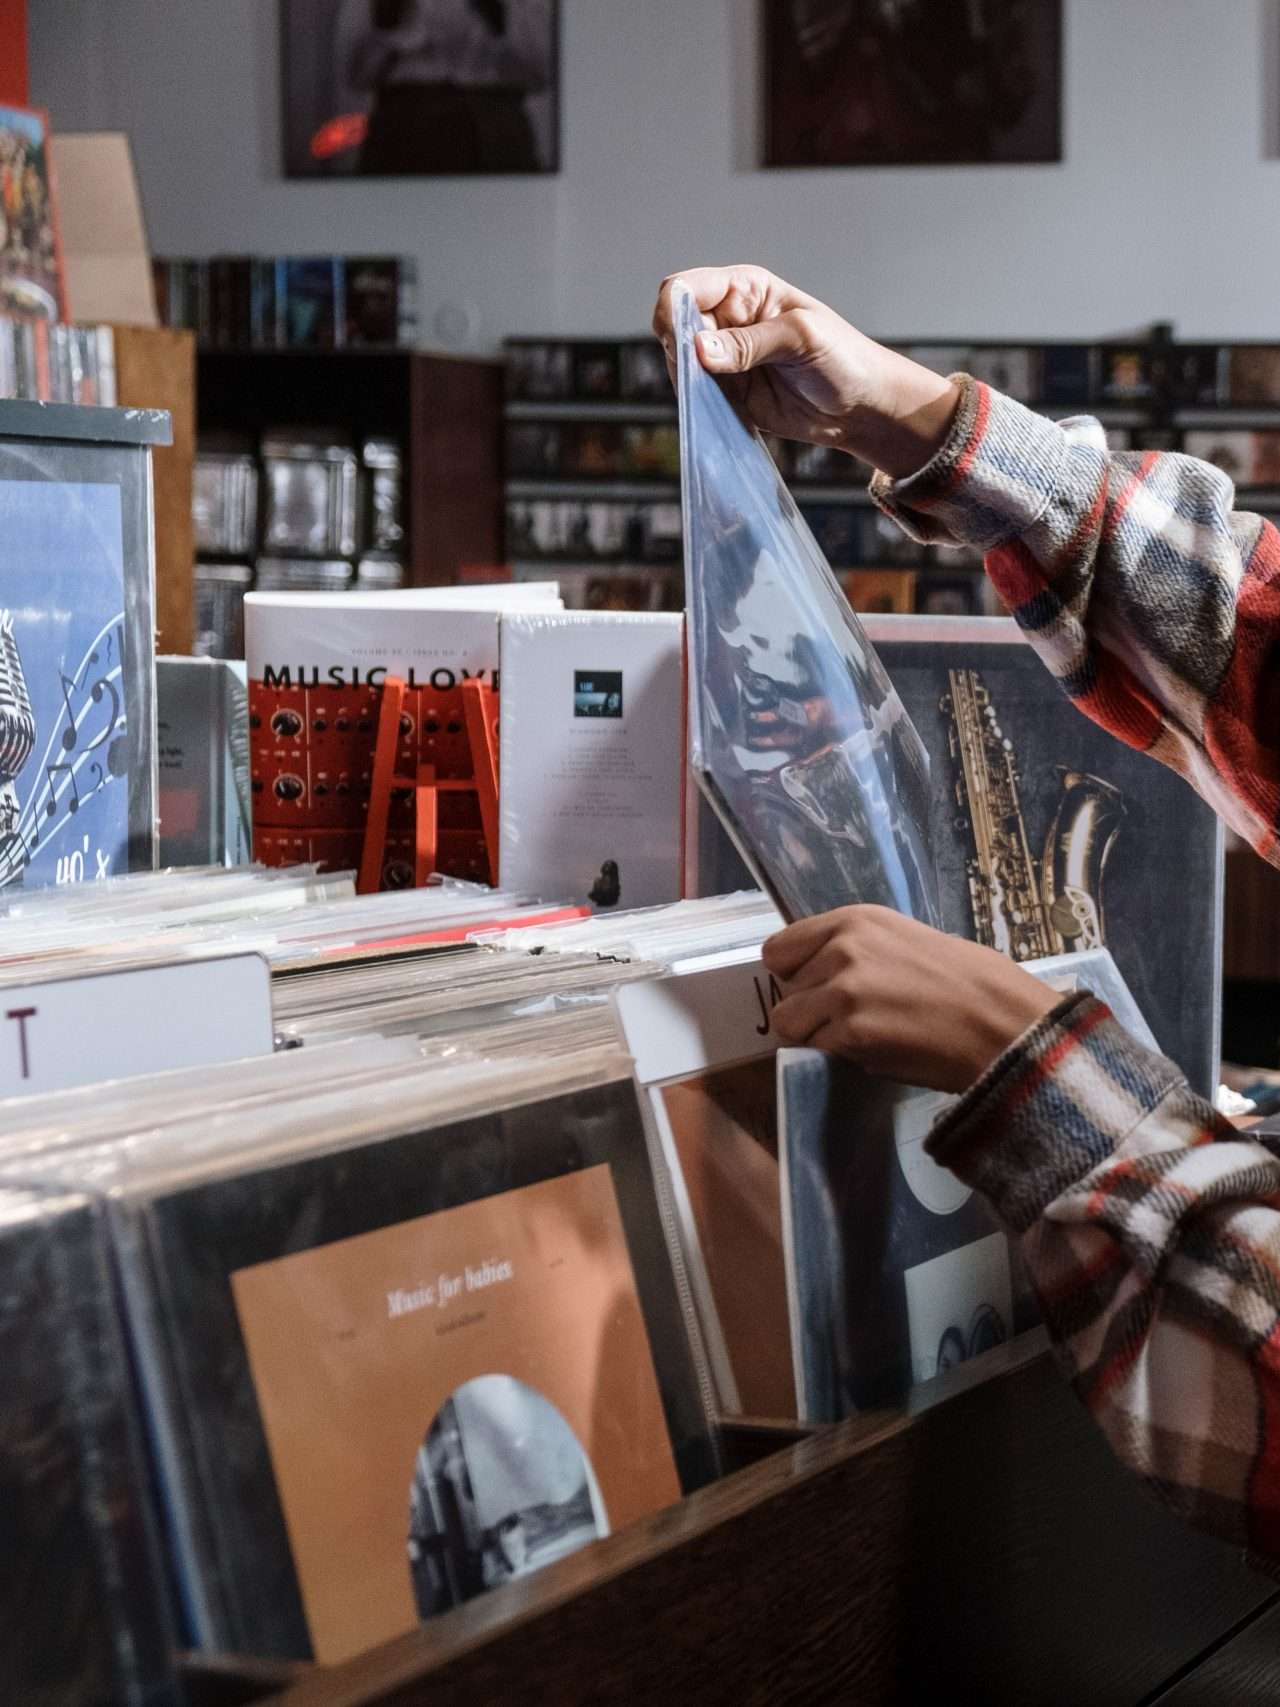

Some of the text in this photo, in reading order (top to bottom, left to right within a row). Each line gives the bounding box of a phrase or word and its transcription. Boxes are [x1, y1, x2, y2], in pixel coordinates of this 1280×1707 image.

[263, 664, 388, 691] MUSIC
[6, 1006, 37, 1079] T
[437, 1273, 463, 1309] for
